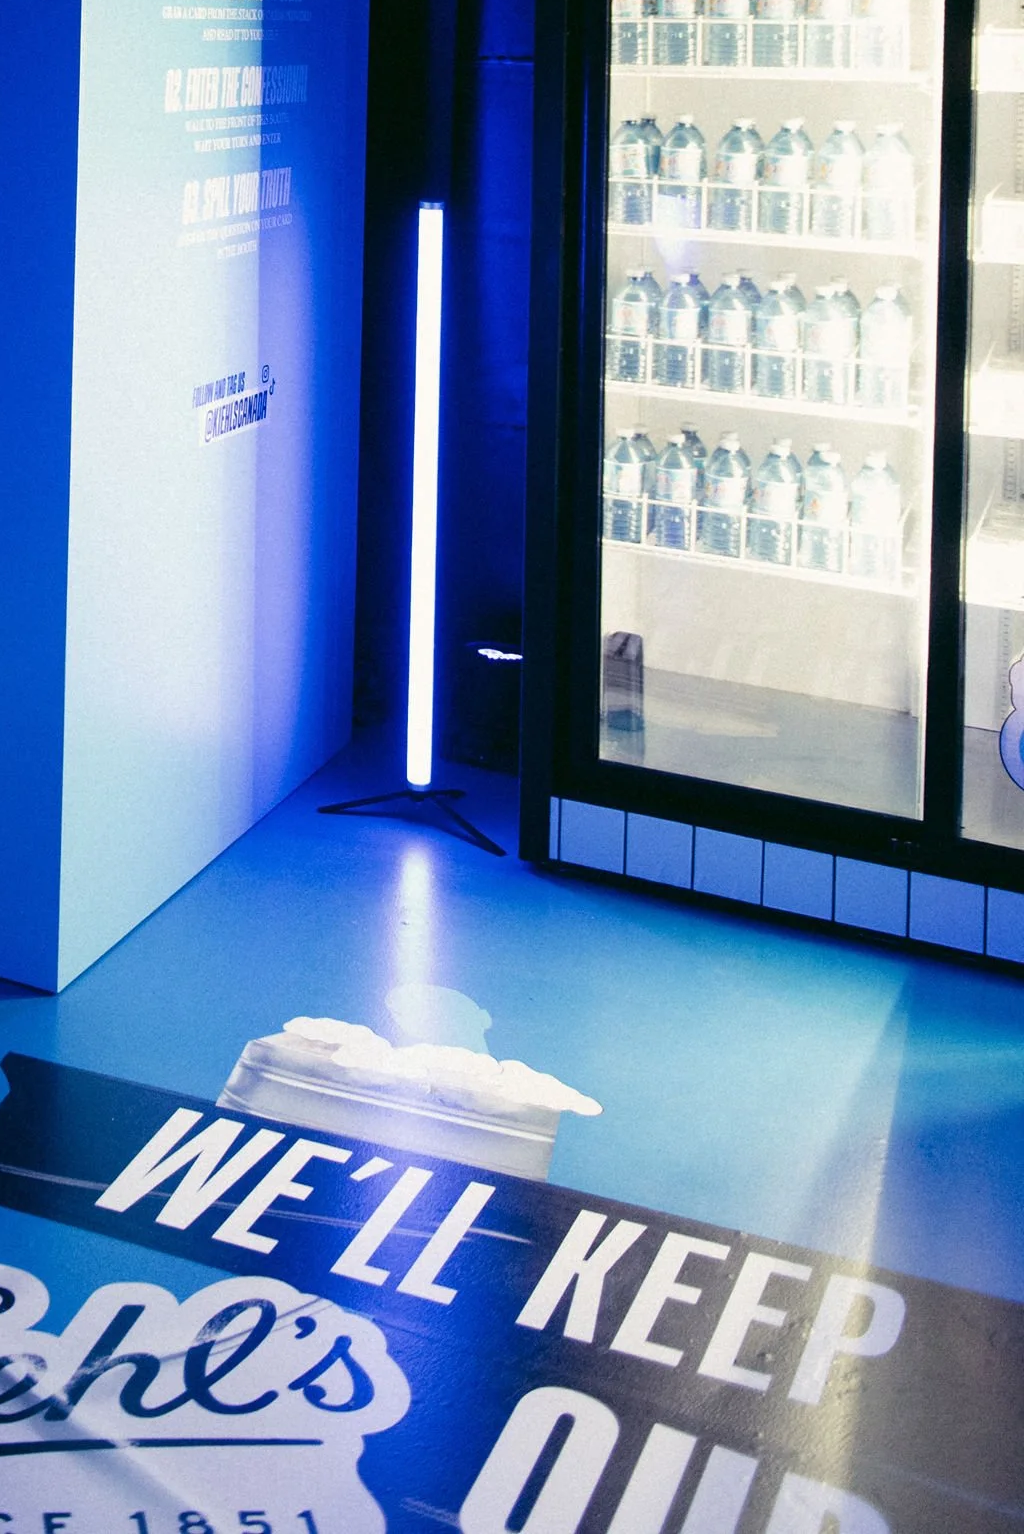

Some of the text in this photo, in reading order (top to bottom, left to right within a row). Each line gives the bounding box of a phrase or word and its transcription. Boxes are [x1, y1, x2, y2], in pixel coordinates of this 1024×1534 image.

[185, 67, 219, 111] ENTER
[221, 66, 241, 109] THE
[203, 176, 231, 221] SPILL
[232, 171, 259, 214] YOUR
[261, 167, 292, 210] TRUTH
[192, 371, 246, 409] FOLLOW AND TAG US
[204, 390, 268, 442] @KIEHLSCANADA
[94, 1107, 907, 1406] WE'LL KEEP
